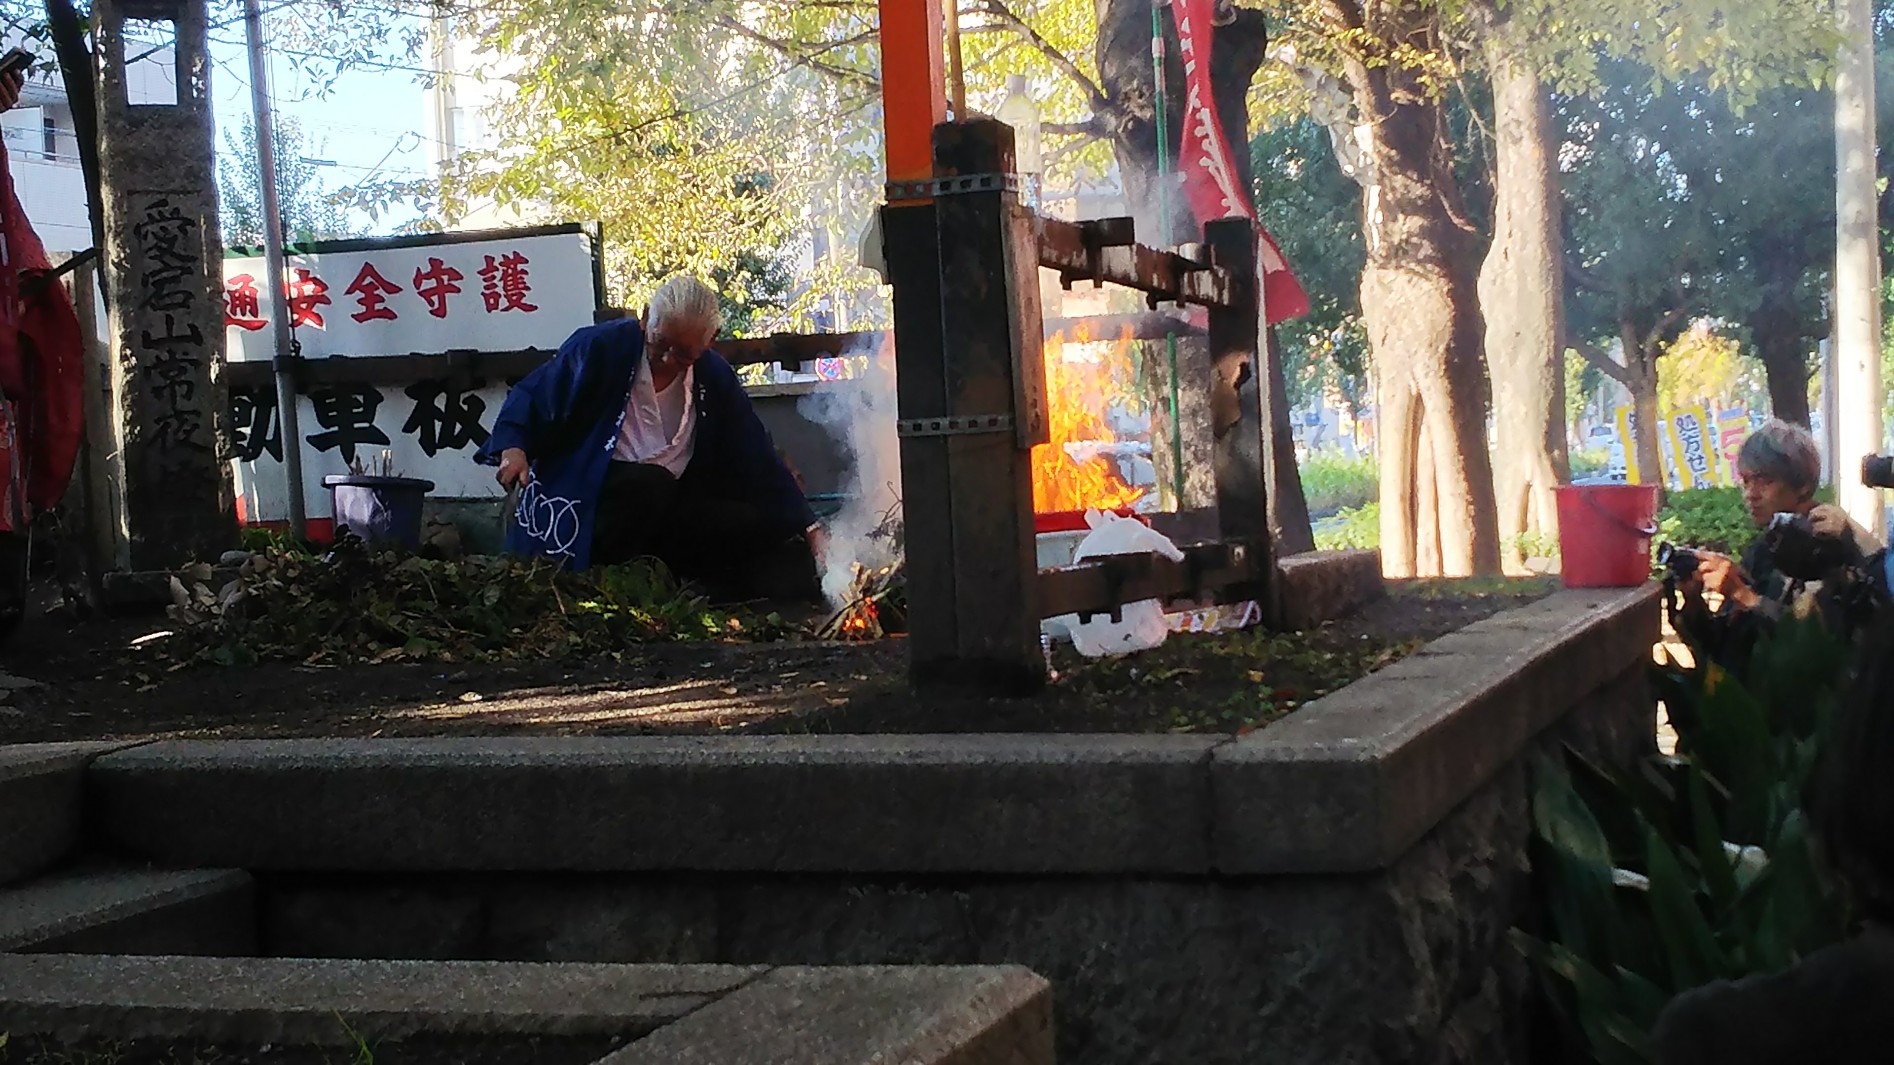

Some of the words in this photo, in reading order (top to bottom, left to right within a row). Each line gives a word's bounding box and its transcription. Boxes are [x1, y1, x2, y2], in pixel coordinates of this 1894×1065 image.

[134, 199, 212, 503] 愛宕山常夜
